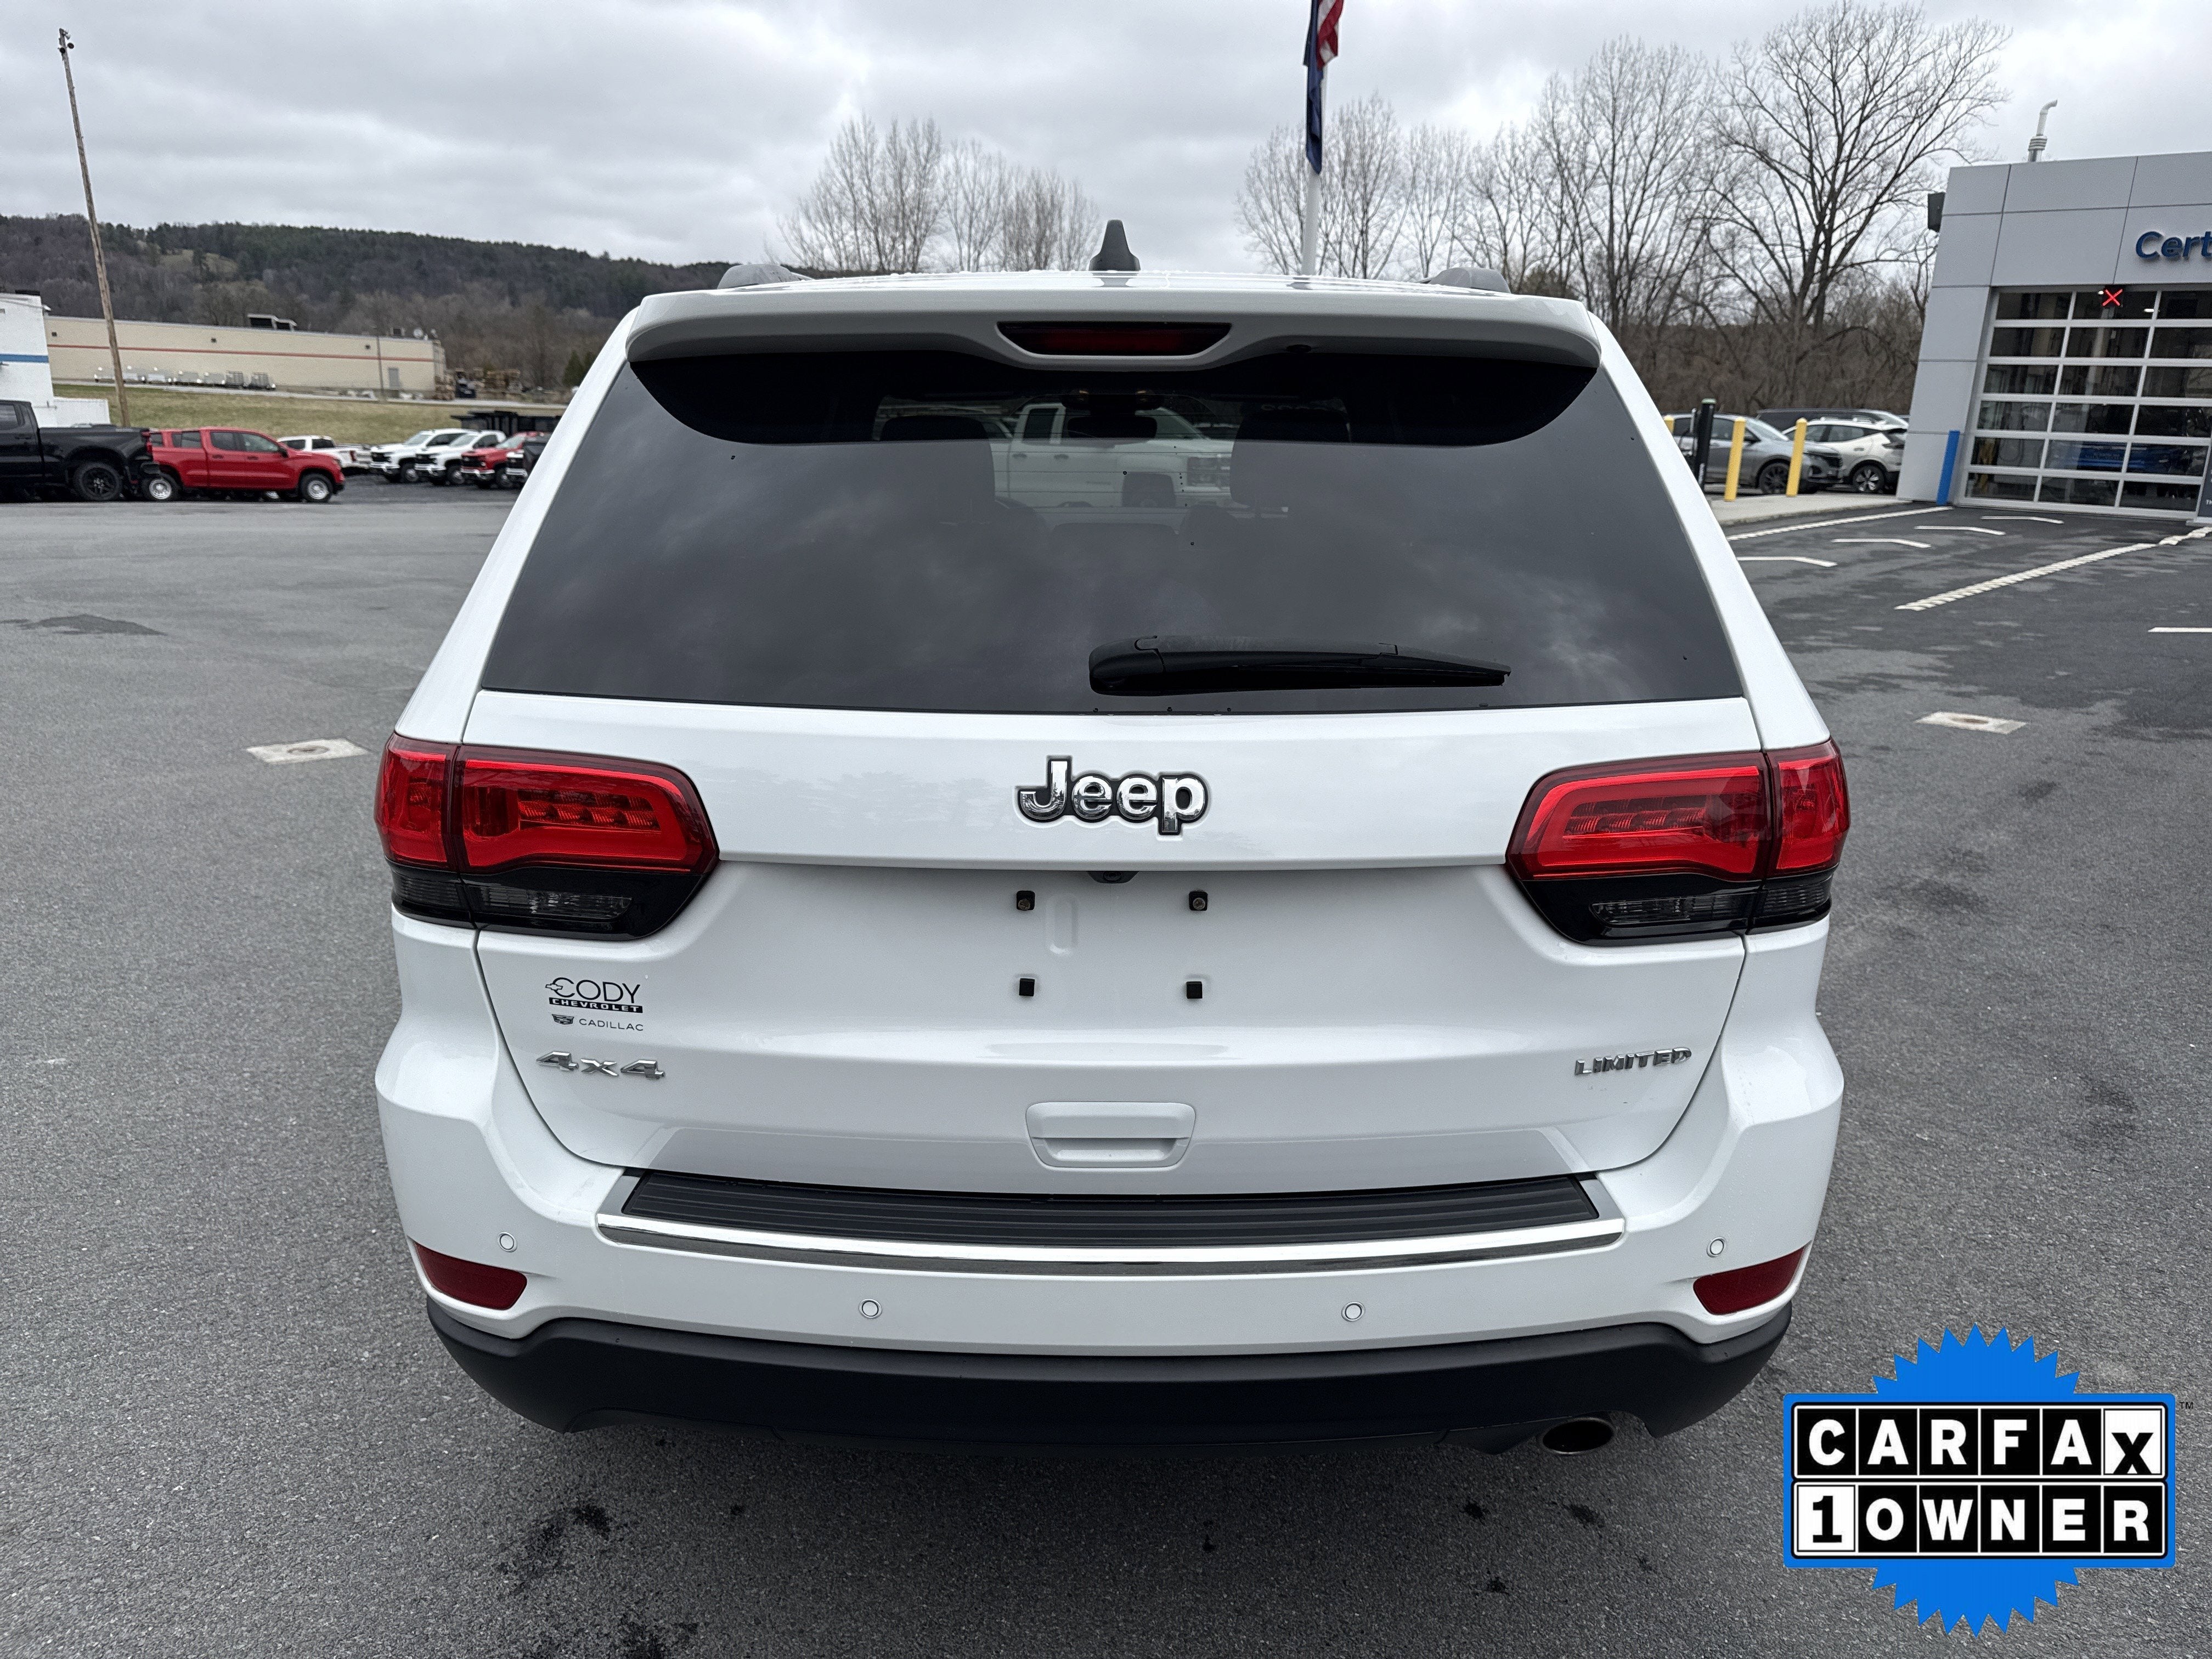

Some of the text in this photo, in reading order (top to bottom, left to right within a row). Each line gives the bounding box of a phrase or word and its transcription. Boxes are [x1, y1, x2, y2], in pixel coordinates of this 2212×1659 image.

[2136, 231, 2212, 259] Cert
[1018, 758, 1208, 836] Jeep
[545, 977, 640, 1003] CODY
[551, 998, 640, 1012] CHEVROLET
[579, 1018, 644, 1031] CADILLAC
[1575, 1047, 1692, 1075] LIMITED
